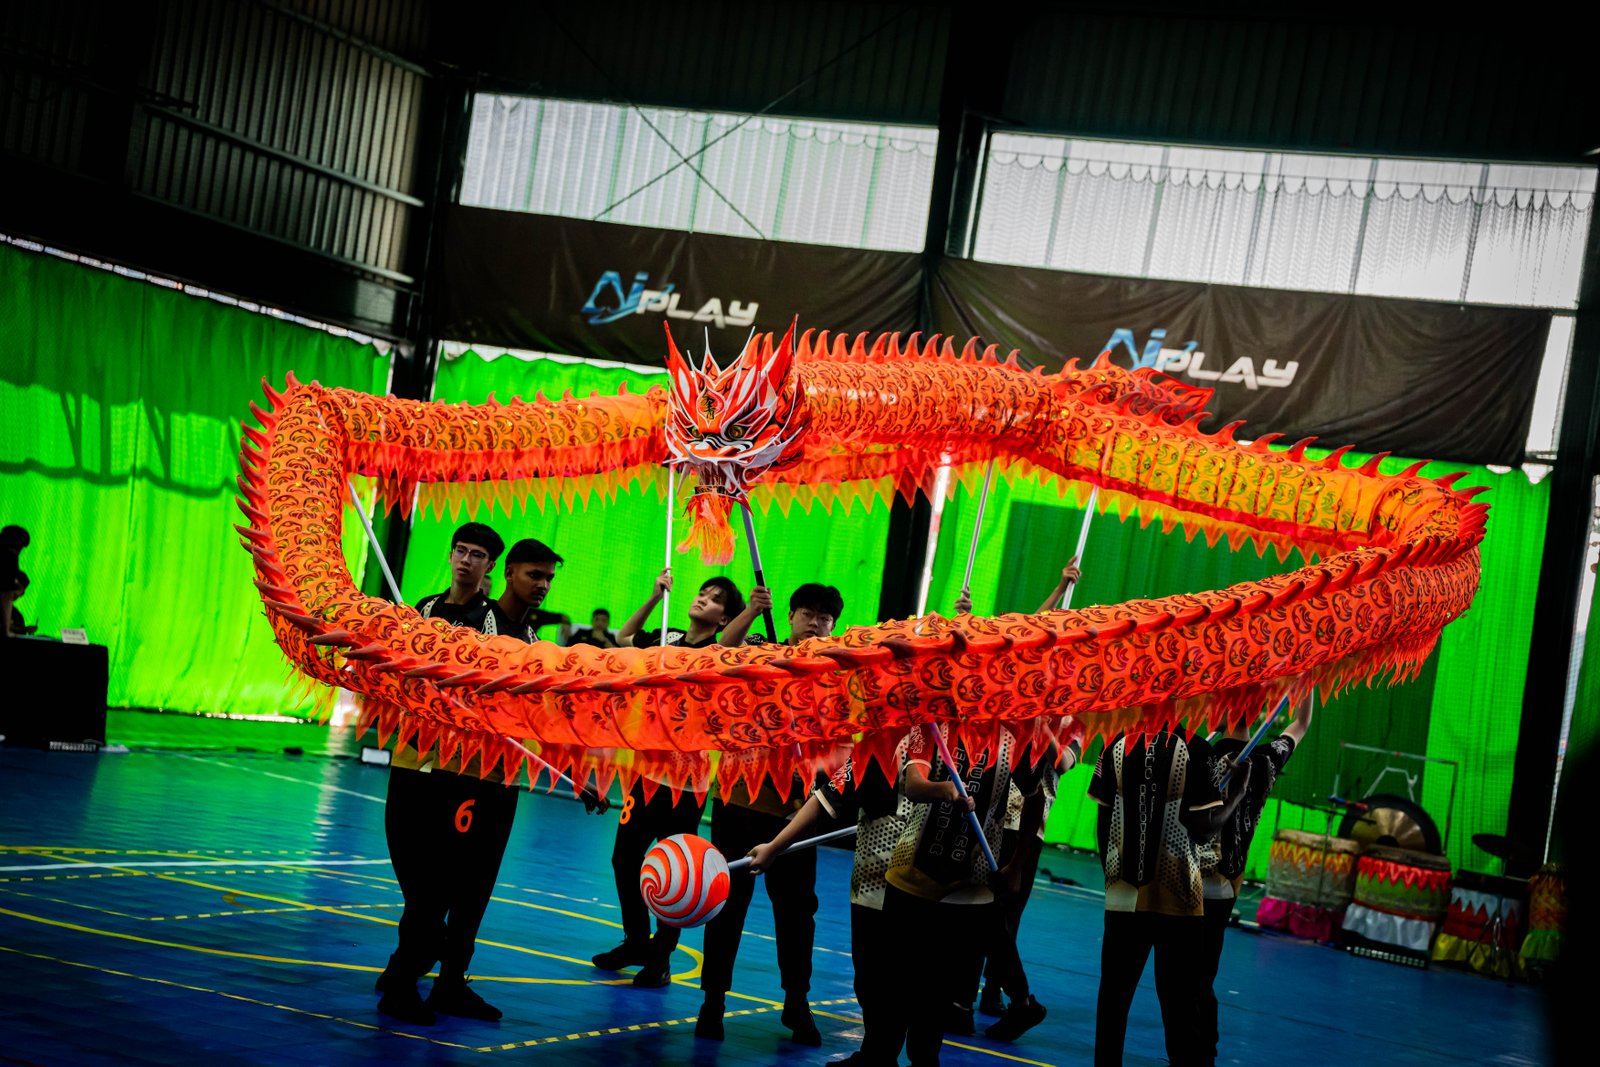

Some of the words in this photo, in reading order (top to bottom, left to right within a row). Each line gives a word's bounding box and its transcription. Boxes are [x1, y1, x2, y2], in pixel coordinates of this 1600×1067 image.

[454, 799, 475, 833] 6
[619, 794, 635, 825] 8
[929, 747, 966, 857] MYSIA
